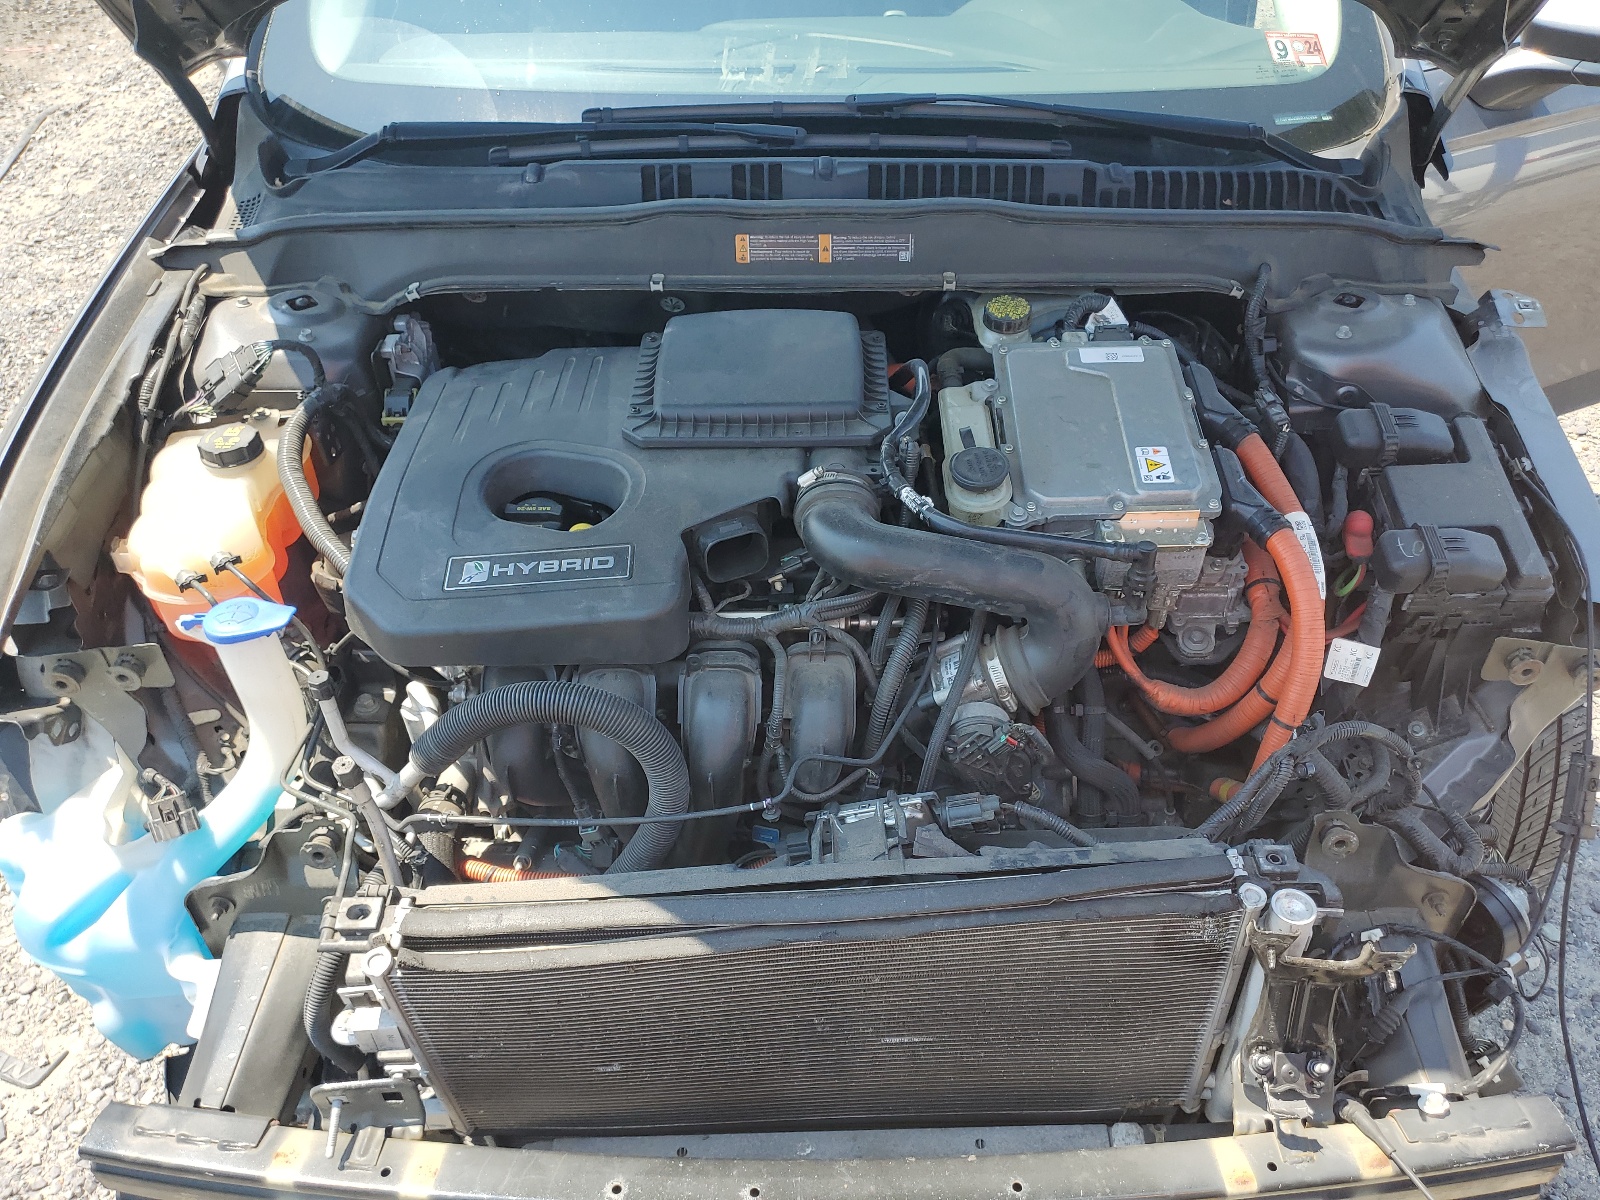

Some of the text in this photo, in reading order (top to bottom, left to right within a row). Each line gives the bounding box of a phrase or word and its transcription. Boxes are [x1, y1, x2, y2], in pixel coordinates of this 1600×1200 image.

[1275, 40, 1288, 59] 9
[1304, 40, 1321, 54] 24
[492, 556, 615, 577] HYBRID
